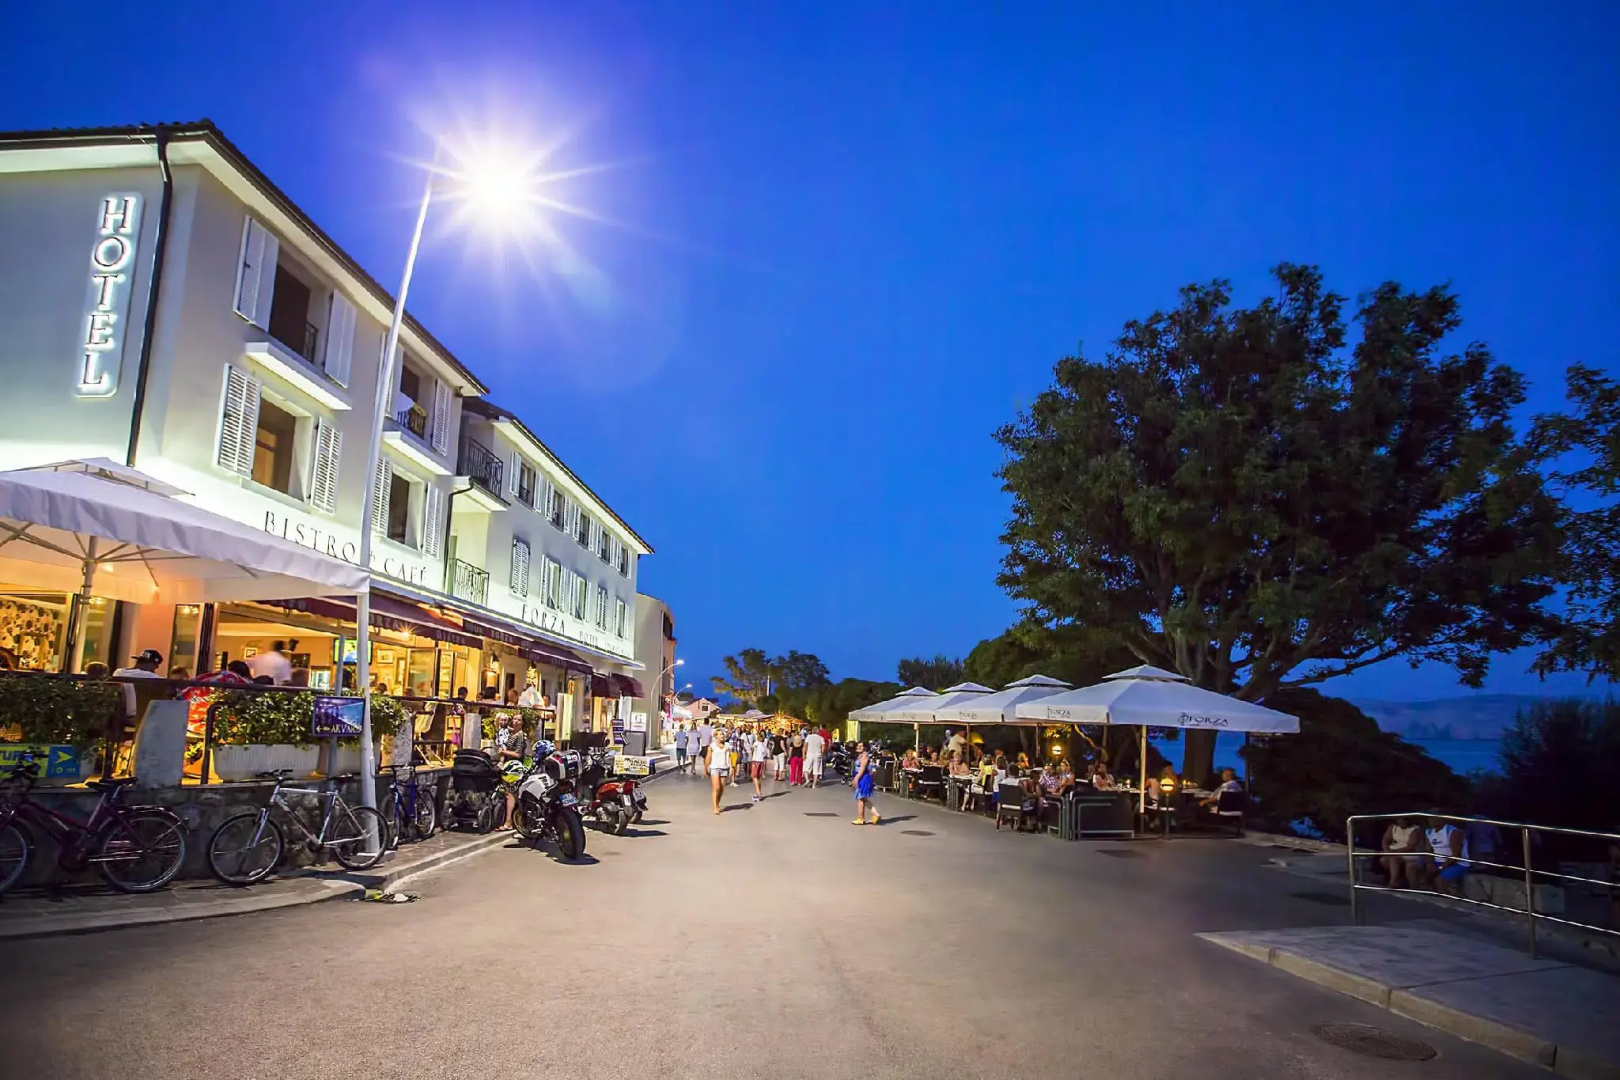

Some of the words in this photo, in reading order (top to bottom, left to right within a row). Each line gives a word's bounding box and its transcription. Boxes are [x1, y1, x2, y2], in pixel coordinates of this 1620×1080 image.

[82, 197, 134, 386] HOTEL
[264, 511, 356, 562] BISTRO
[521, 603, 565, 636] FORZA
[1189, 715, 1229, 725] FORZA
